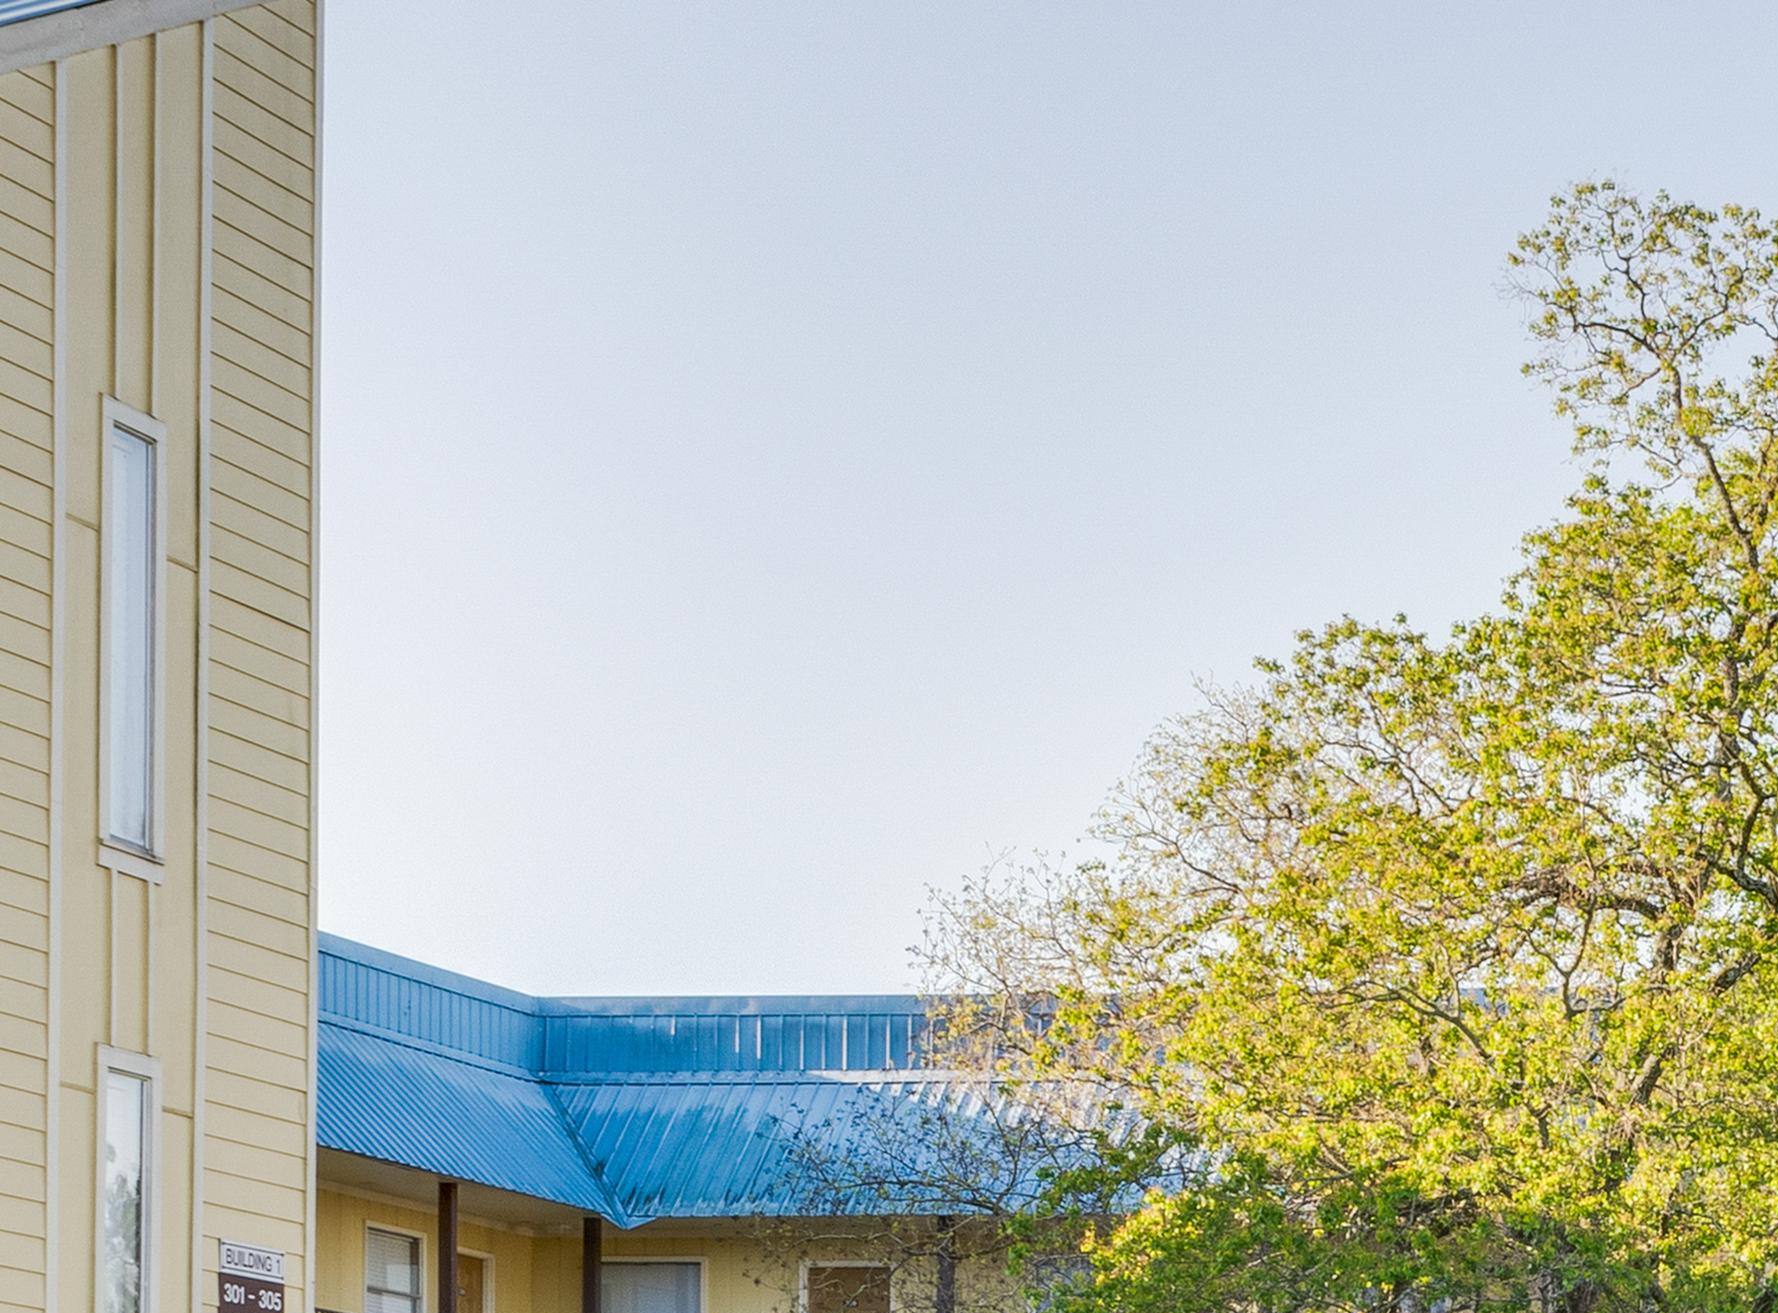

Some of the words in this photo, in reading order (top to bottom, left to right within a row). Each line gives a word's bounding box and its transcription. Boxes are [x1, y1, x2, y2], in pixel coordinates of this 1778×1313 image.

[226, 1248, 272, 1272] BUILDING
[224, 1283, 245, 1305] 301
[258, 1290, 282, 1312] 305
